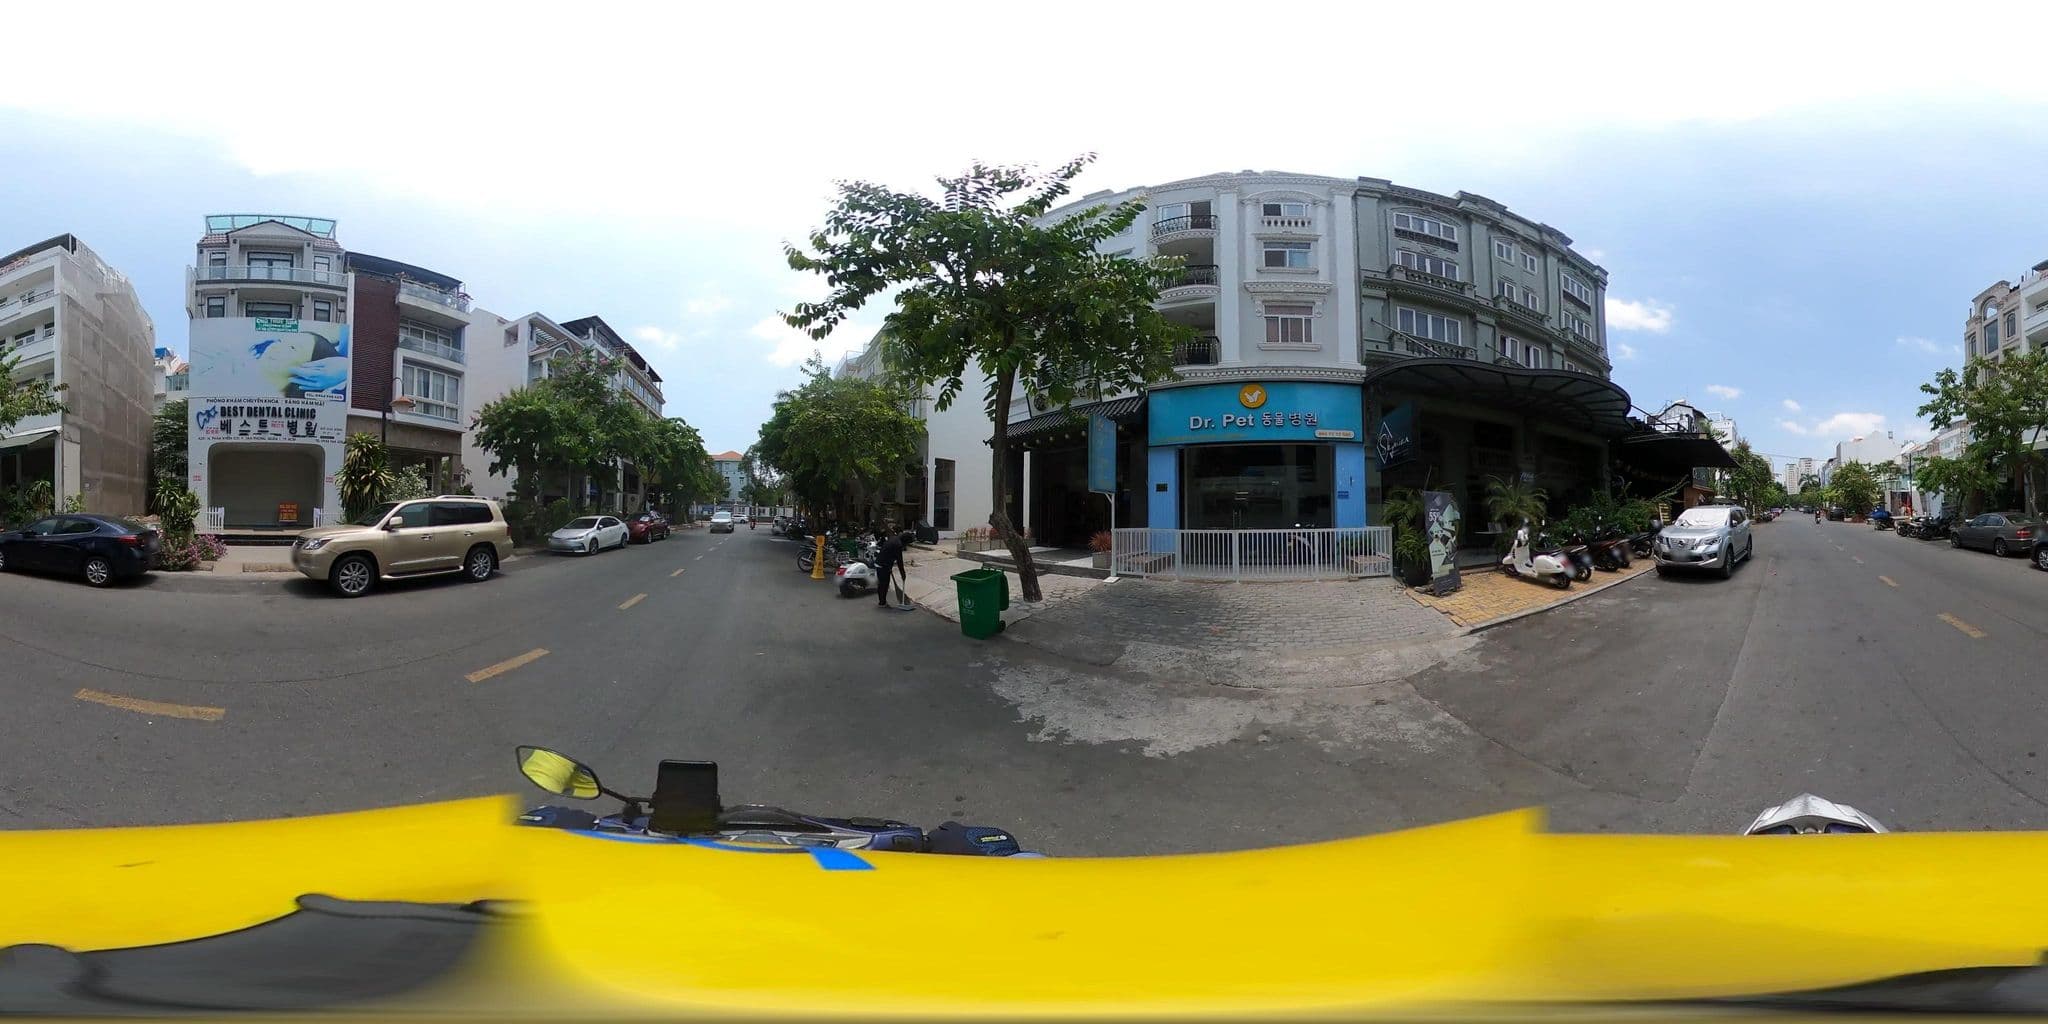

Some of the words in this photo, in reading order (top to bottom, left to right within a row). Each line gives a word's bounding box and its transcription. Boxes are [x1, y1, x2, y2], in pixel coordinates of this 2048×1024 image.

[220, 405, 244, 417] BEST
[247, 406, 283, 418] DENTAL
[285, 408, 316, 420] CLINIC
[1189, 416, 1215, 430] Dr.
[1222, 413, 1255, 427] Pet
